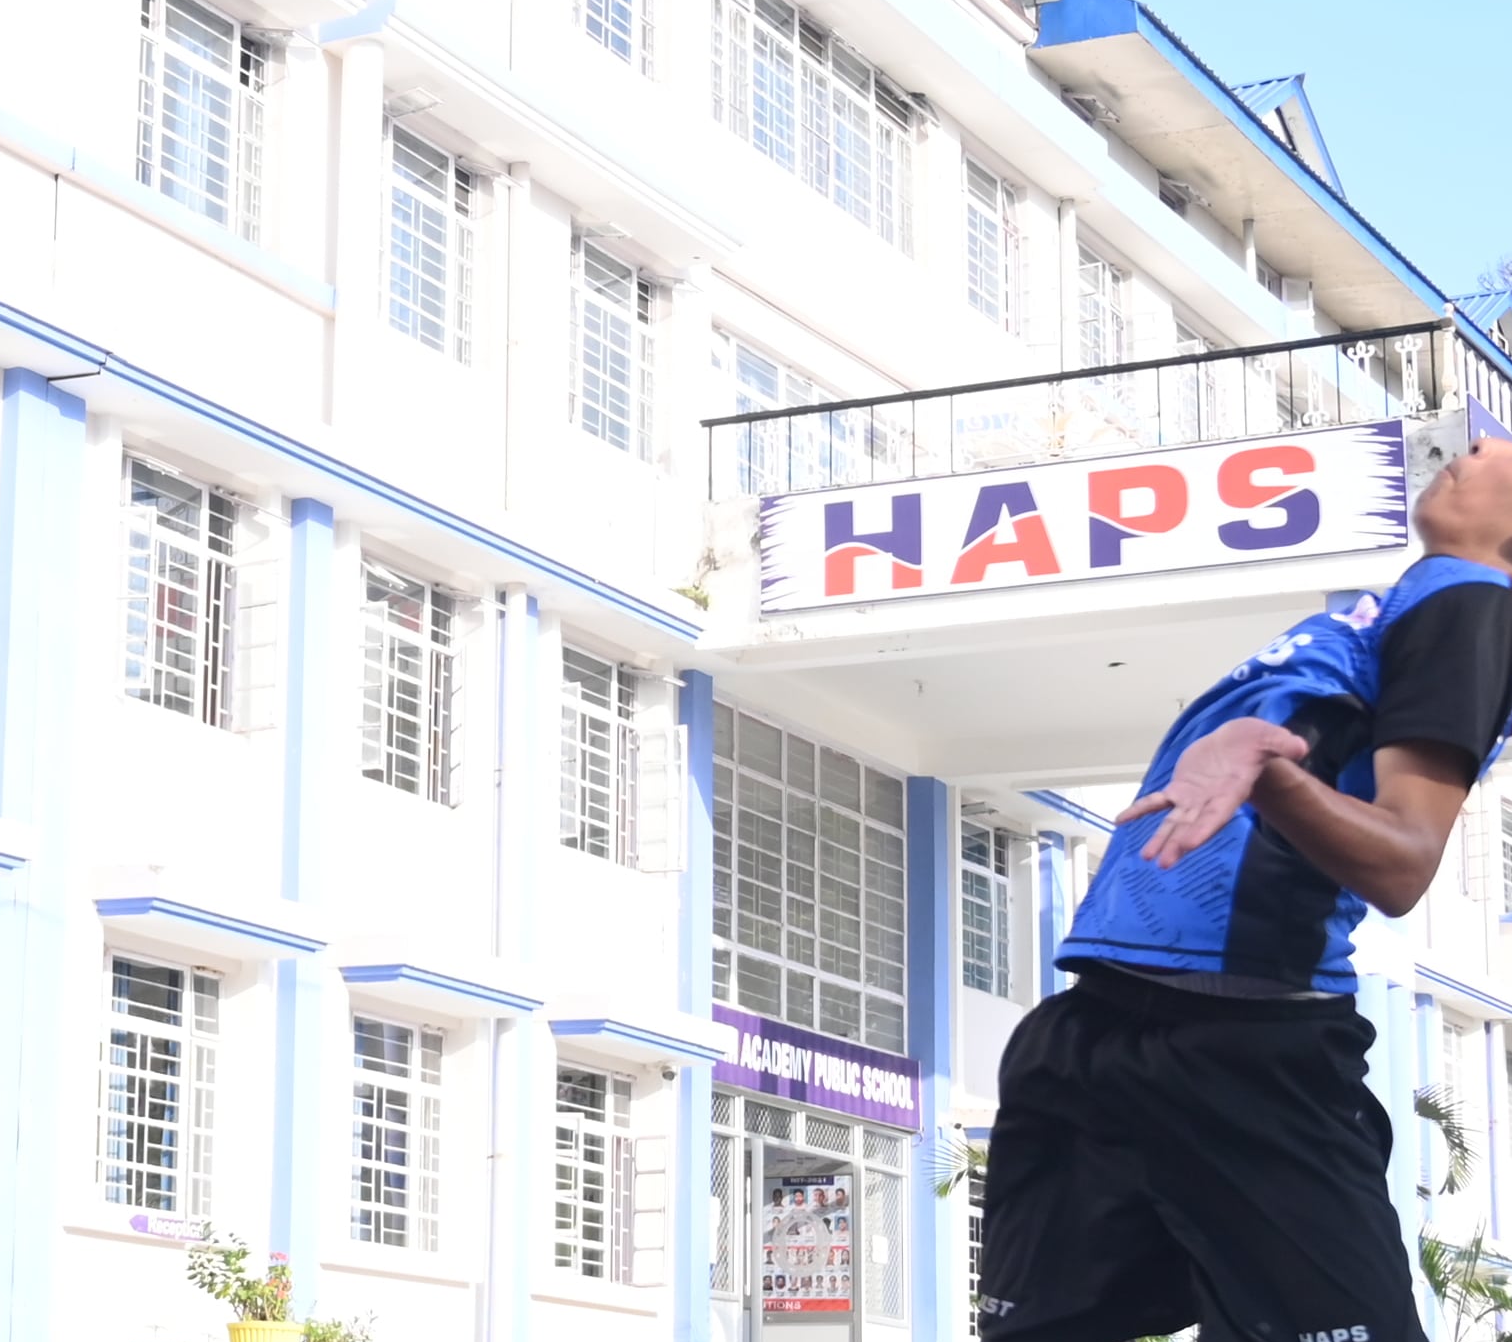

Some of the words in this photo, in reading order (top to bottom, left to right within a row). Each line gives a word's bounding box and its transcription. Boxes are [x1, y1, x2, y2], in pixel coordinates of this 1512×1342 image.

[823, 445, 1321, 597] HAPS
[740, 1032, 812, 1084] ACADEMY
[814, 1051, 862, 1098] PUBLIC
[862, 1064, 914, 1110] SCHOOL
